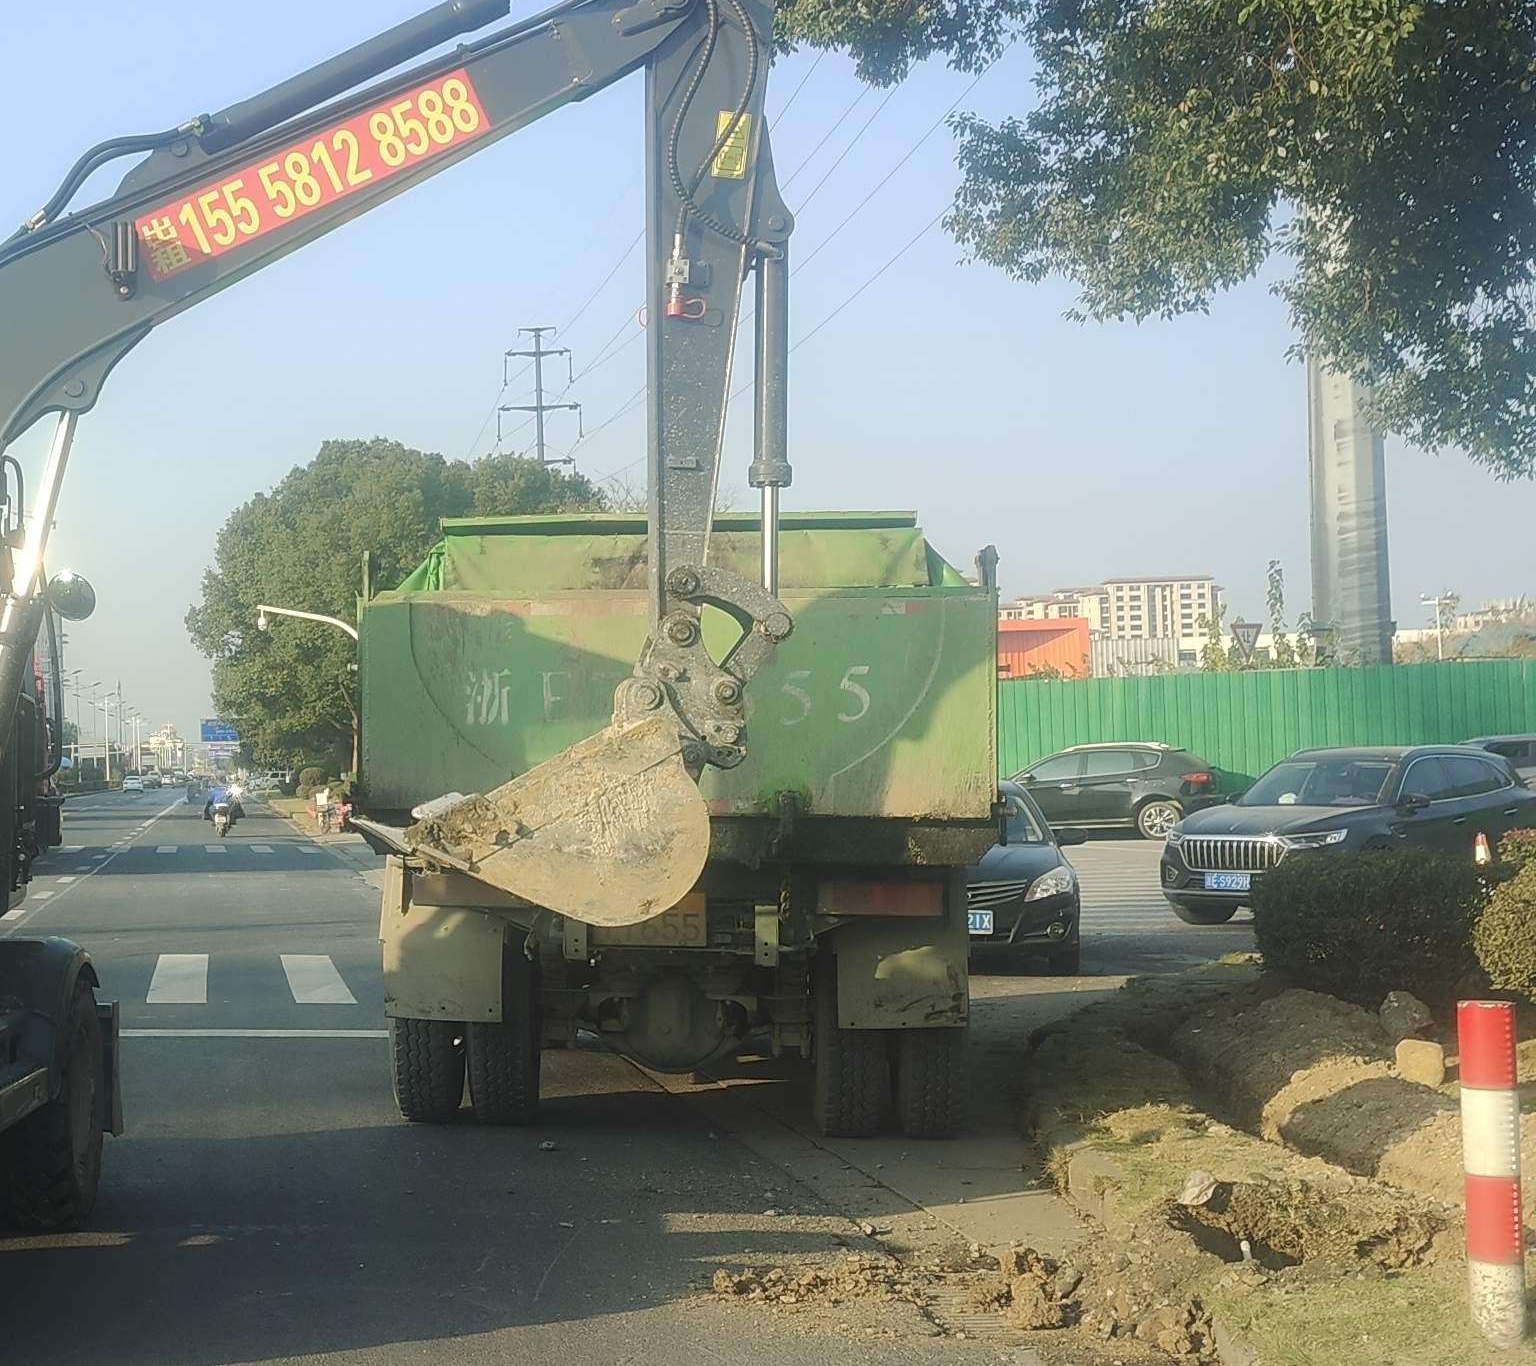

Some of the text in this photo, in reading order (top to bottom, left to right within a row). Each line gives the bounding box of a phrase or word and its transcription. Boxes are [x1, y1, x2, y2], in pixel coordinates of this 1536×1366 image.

[178, 78, 480, 254] 155 5812 8588
[142, 215, 192, 275] 出租
